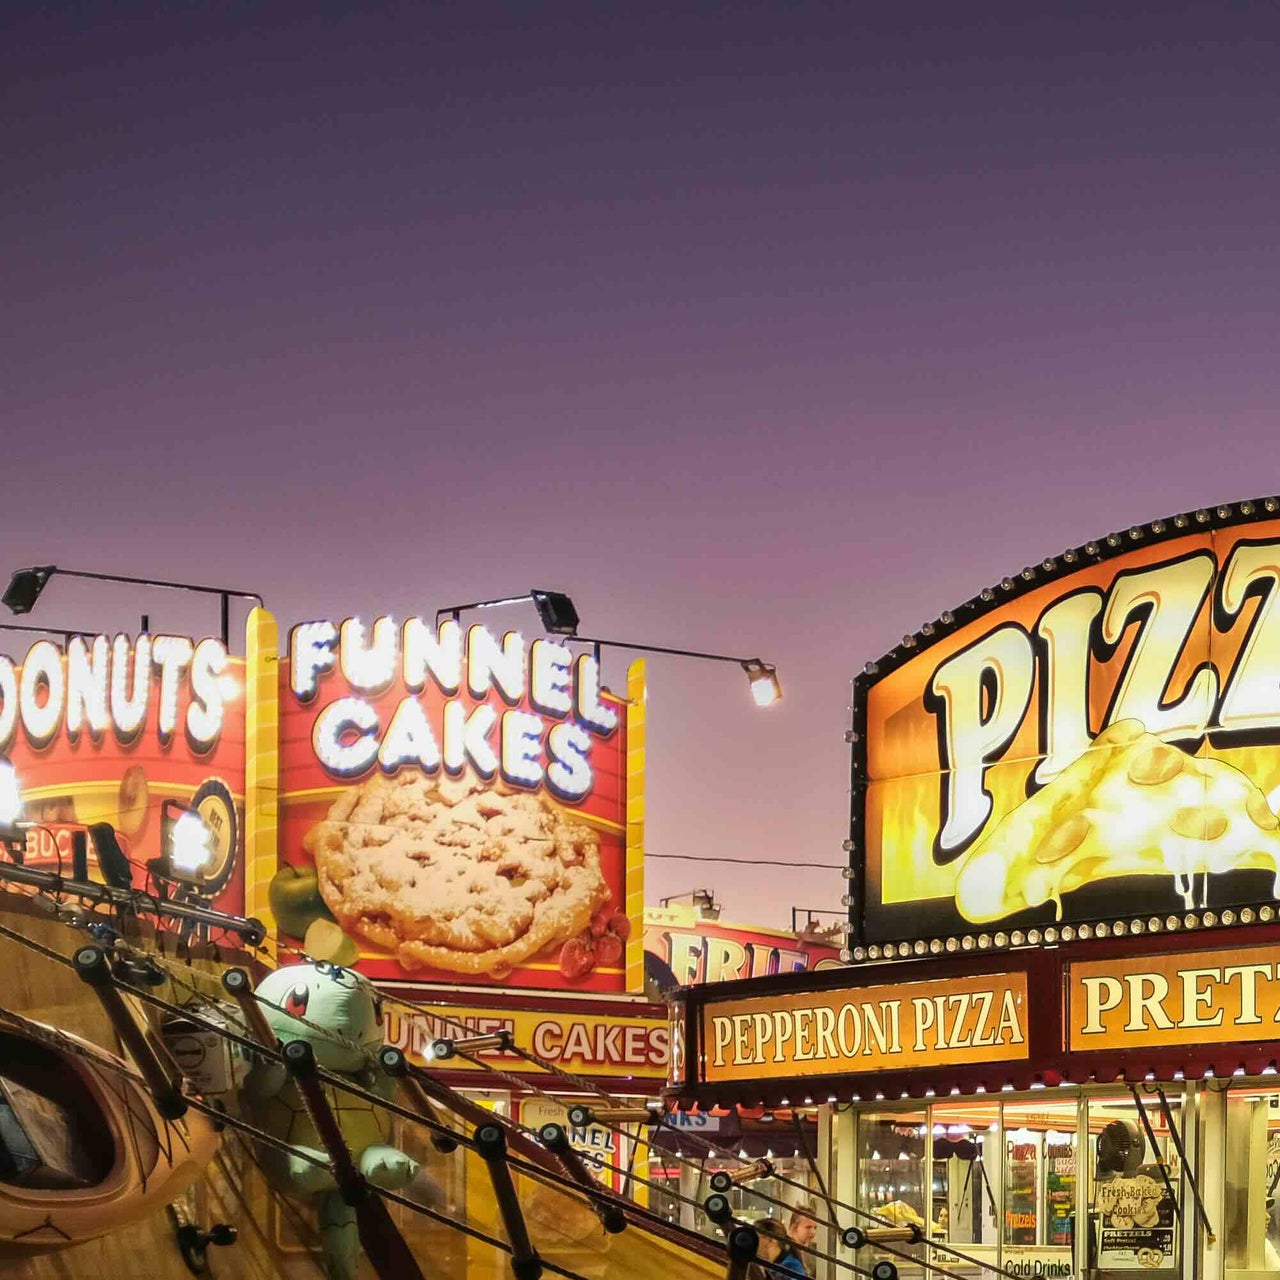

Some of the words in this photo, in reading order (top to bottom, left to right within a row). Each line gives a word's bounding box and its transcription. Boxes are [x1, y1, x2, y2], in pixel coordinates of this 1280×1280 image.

[289, 615, 618, 737] FUNNEL
[312, 696, 592, 804] CAKES
[664, 931, 848, 985] FRI
[532, 1020, 668, 1065] CAKES
[712, 1000, 902, 1067] PEPPERONI
[911, 989, 1025, 1051] PIZZA
[1102, 1187, 1127, 1197] Fresh
[1130, 1186, 1157, 1197] Baked
[1113, 1204, 1146, 1215] Cookies
[1005, 1260, 1031, 1276] Cold
[1034, 1259, 1071, 1276] Drinks
